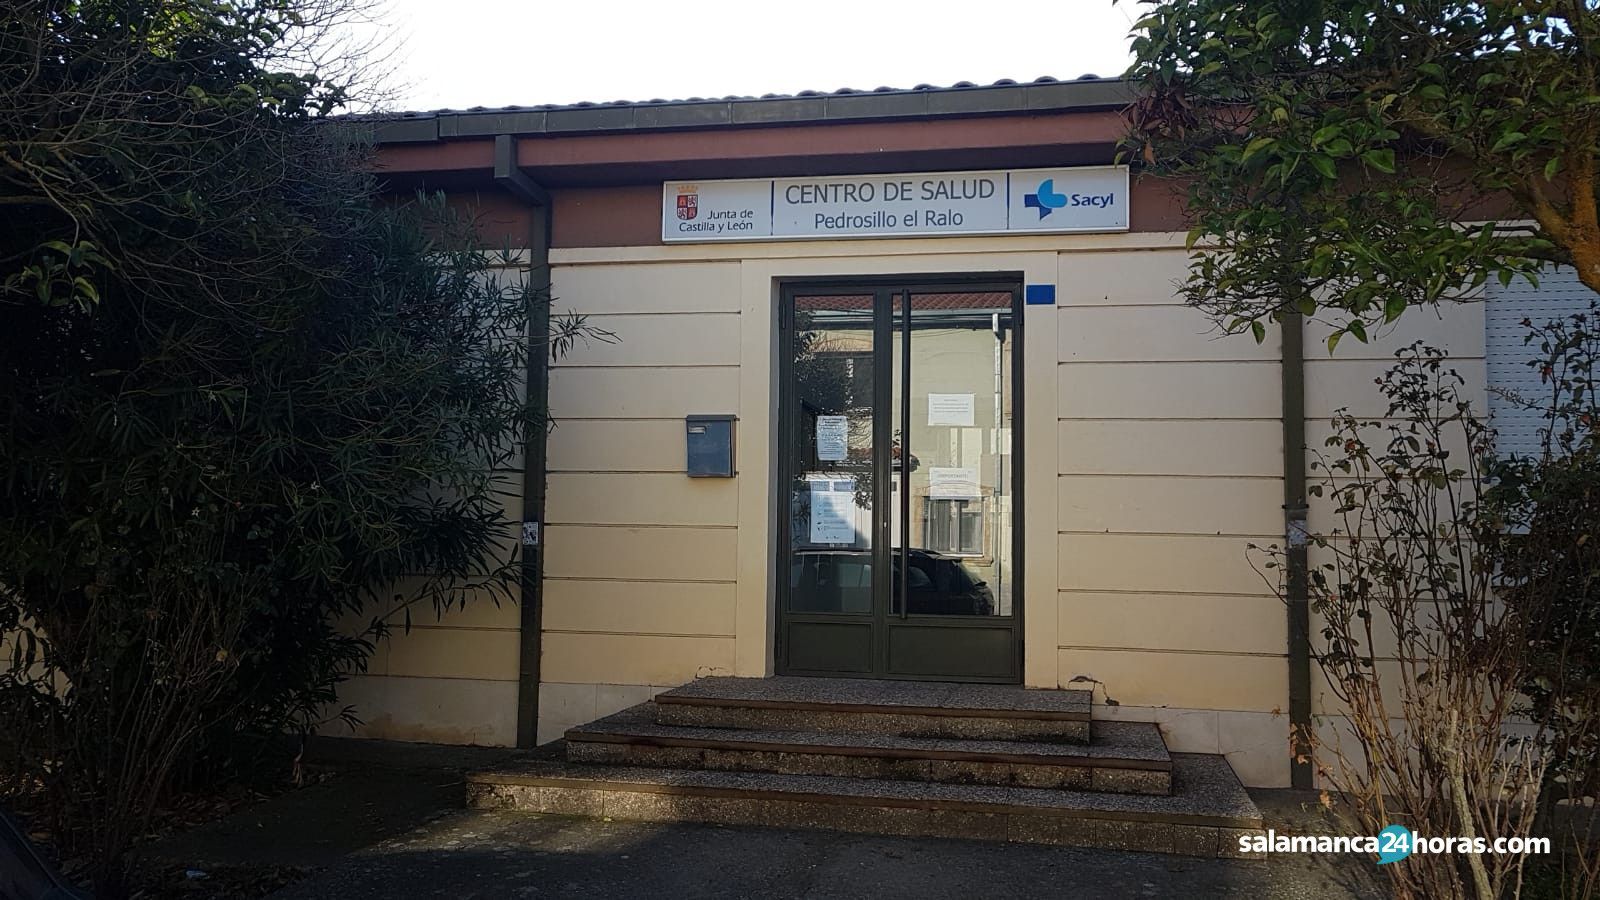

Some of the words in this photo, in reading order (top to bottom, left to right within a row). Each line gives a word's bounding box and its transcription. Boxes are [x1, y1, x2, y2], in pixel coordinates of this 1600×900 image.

[785, 182, 875, 205] CENTRO
[883, 181, 913, 201] DE
[921, 179, 995, 200] SALUD
[1071, 193, 1114, 208] Sacyl
[707, 210, 737, 220] Junta
[740, 209, 754, 219] de
[815, 211, 897, 229] Pedrosillo
[903, 210, 918, 227] el
[925, 209, 963, 227] Ralo
[679, 222, 715, 232] Castilla
[717, 223, 725, 233] y
[727, 220, 753, 230] León
